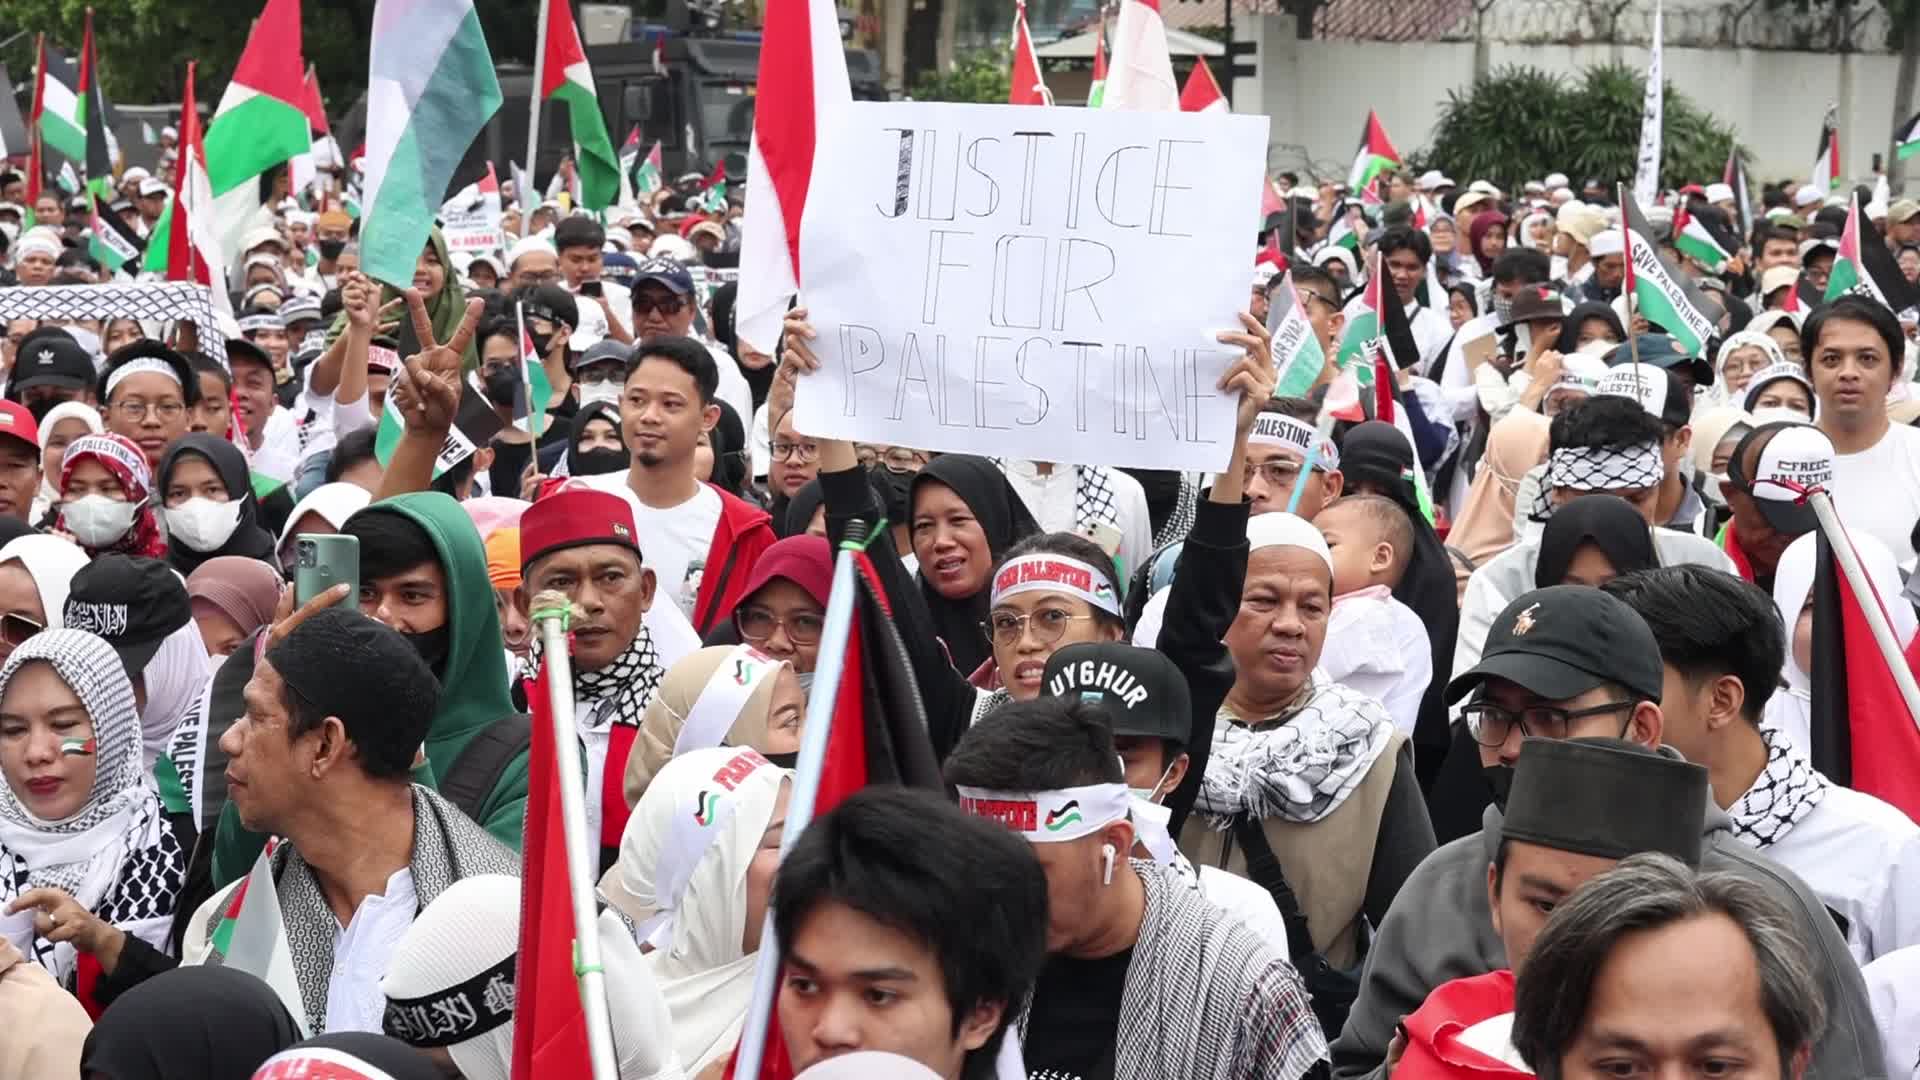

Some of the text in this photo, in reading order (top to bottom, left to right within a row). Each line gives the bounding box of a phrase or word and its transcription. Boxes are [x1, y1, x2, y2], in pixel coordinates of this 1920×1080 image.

[876, 128, 1205, 237] JUSTICE
[922, 229, 1115, 331] FOR
[1632, 243, 1657, 274] SAVE
[839, 322, 1220, 444] PALESTINE
[1049, 660, 1149, 710] UYGHUR
